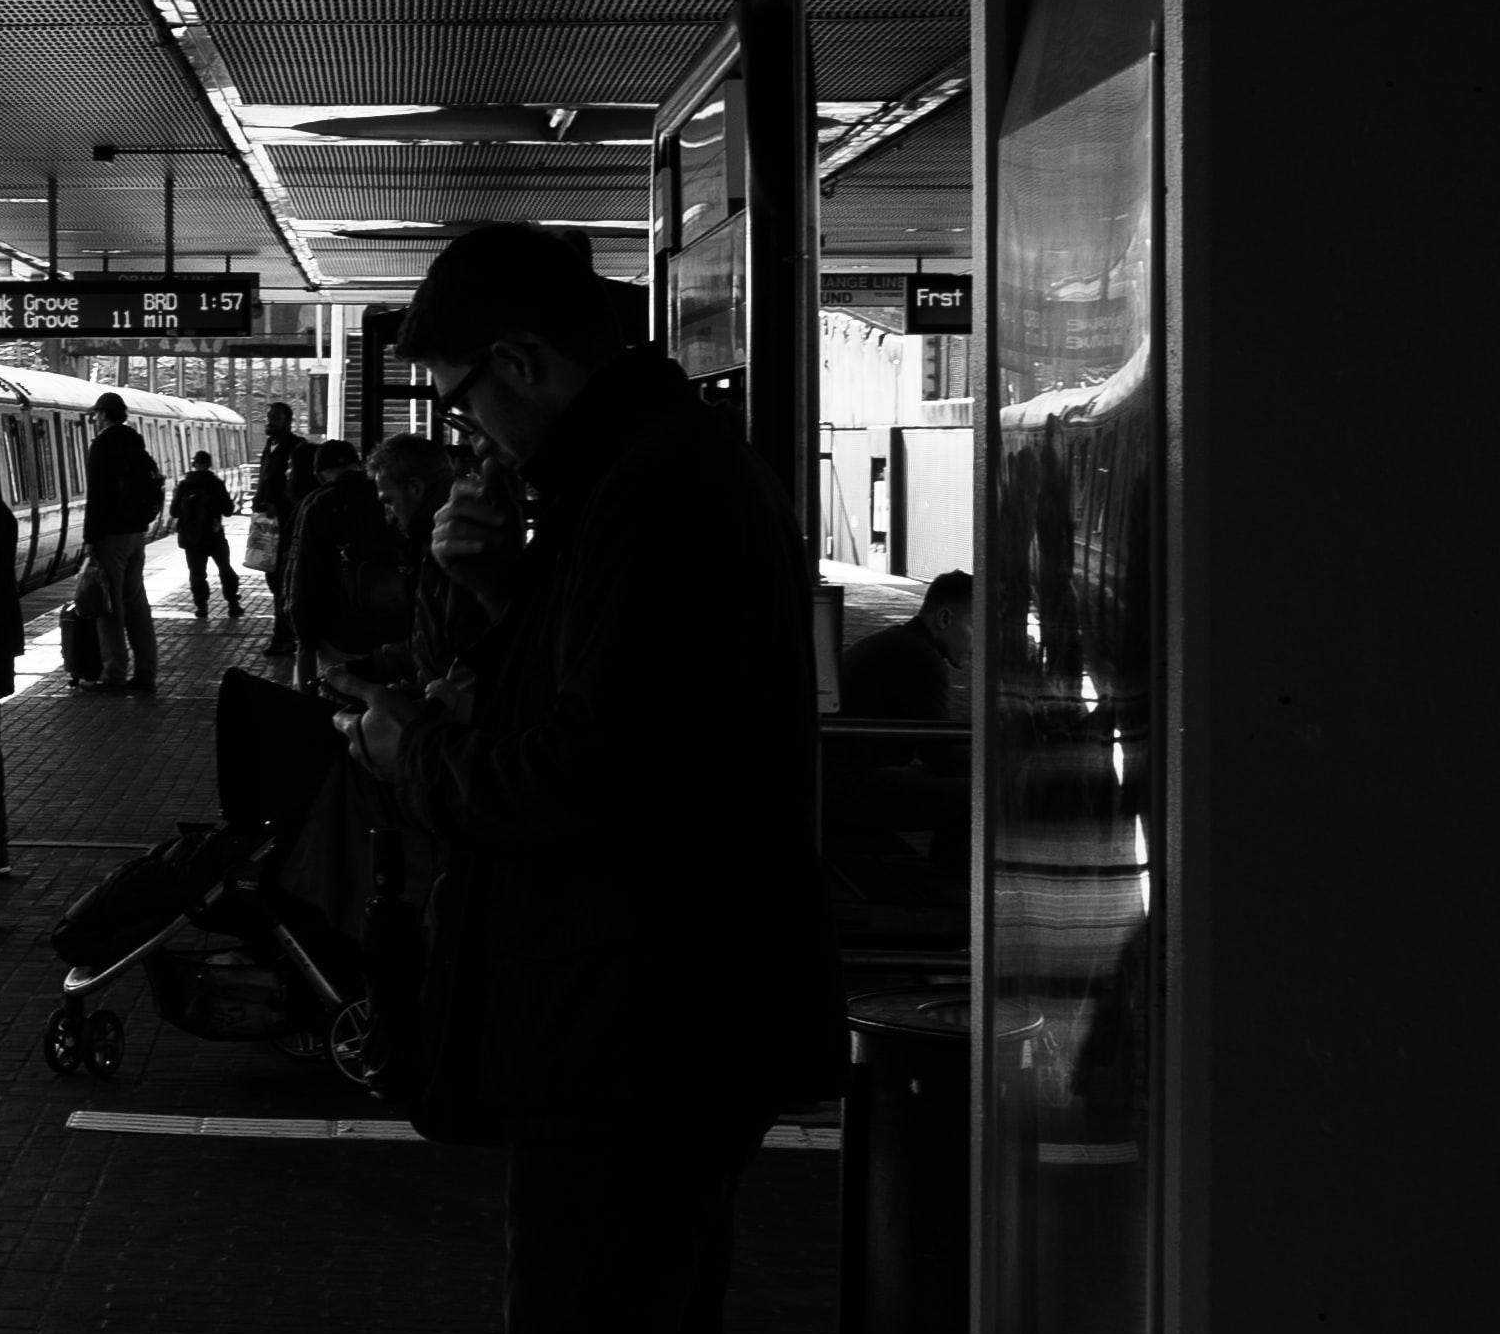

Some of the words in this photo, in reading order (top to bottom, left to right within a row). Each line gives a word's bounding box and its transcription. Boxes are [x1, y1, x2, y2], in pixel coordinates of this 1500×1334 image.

[23, 293, 80, 312] Grove
[143, 292, 178, 312] BRD
[199, 292, 245, 311] 1:57
[916, 288, 964, 307] Frst
[23, 311, 80, 330] Grove
[112, 310, 132, 329] 11
[143, 311, 179, 329] min
